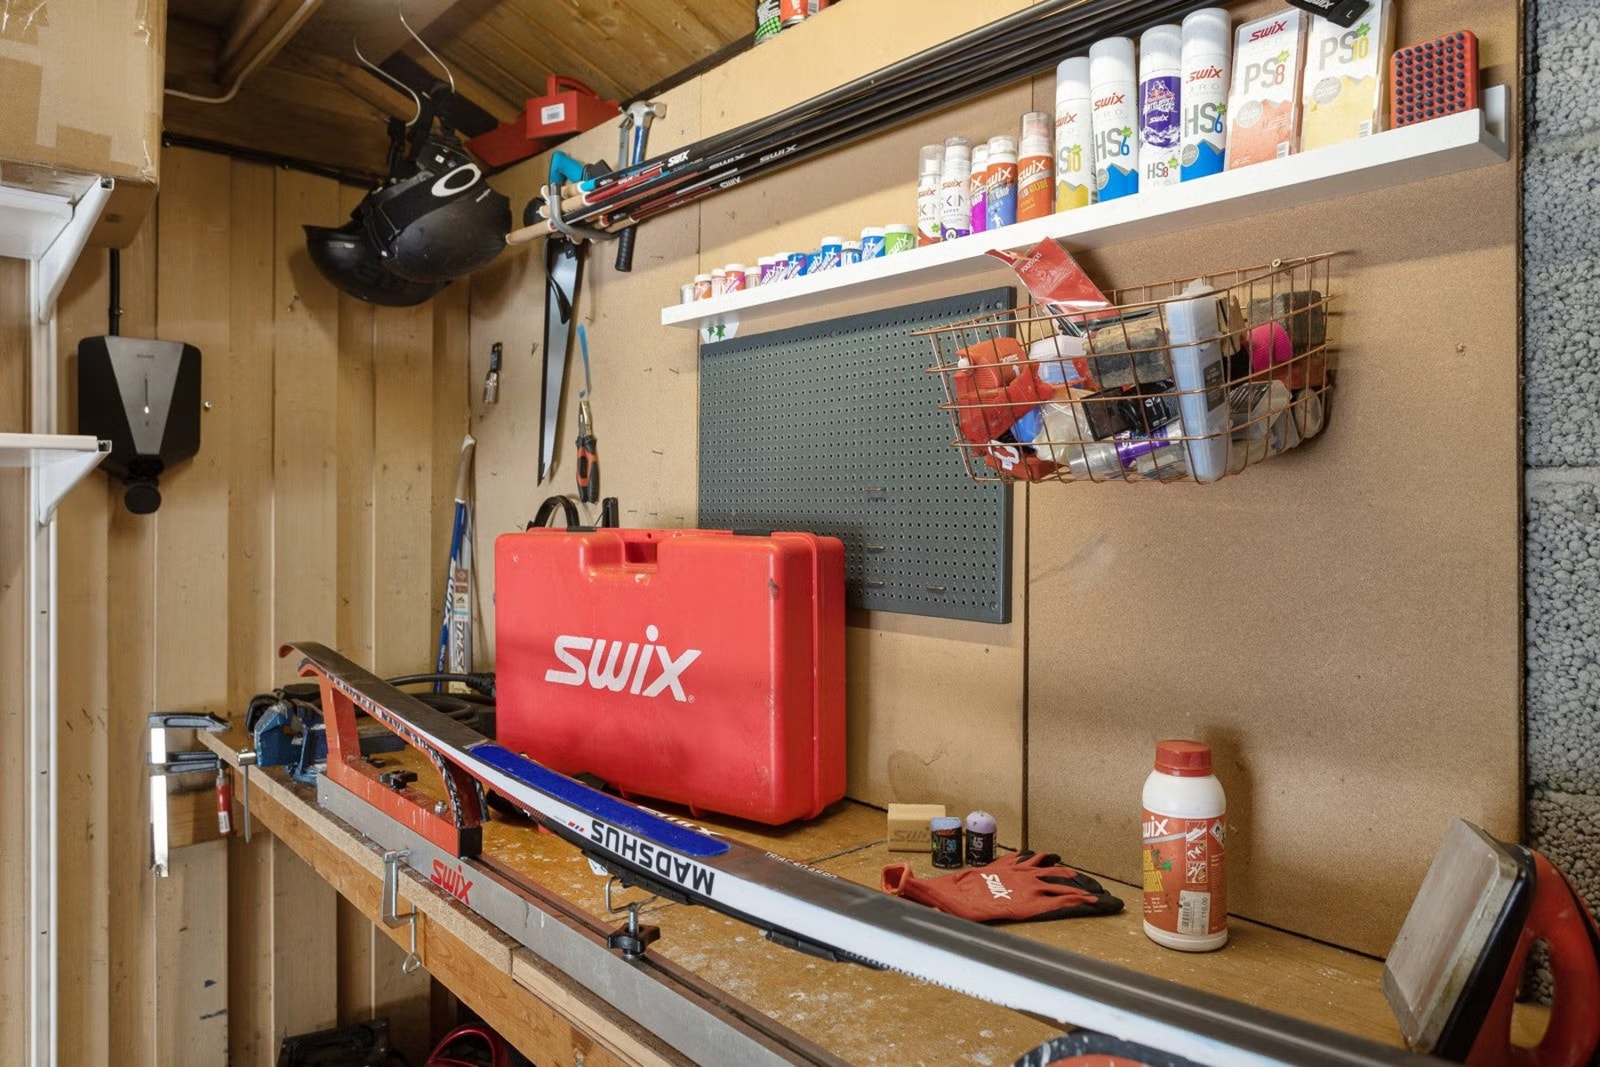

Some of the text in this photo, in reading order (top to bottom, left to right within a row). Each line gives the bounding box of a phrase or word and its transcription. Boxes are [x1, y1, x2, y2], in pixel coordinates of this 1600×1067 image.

[1243, 56, 1286, 95] PS8
[1184, 101, 1224, 138] HS6
[1095, 127, 1130, 163] HS6
[1147, 160, 1169, 180] HS8
[591, 819, 715, 896] MADSHUS
